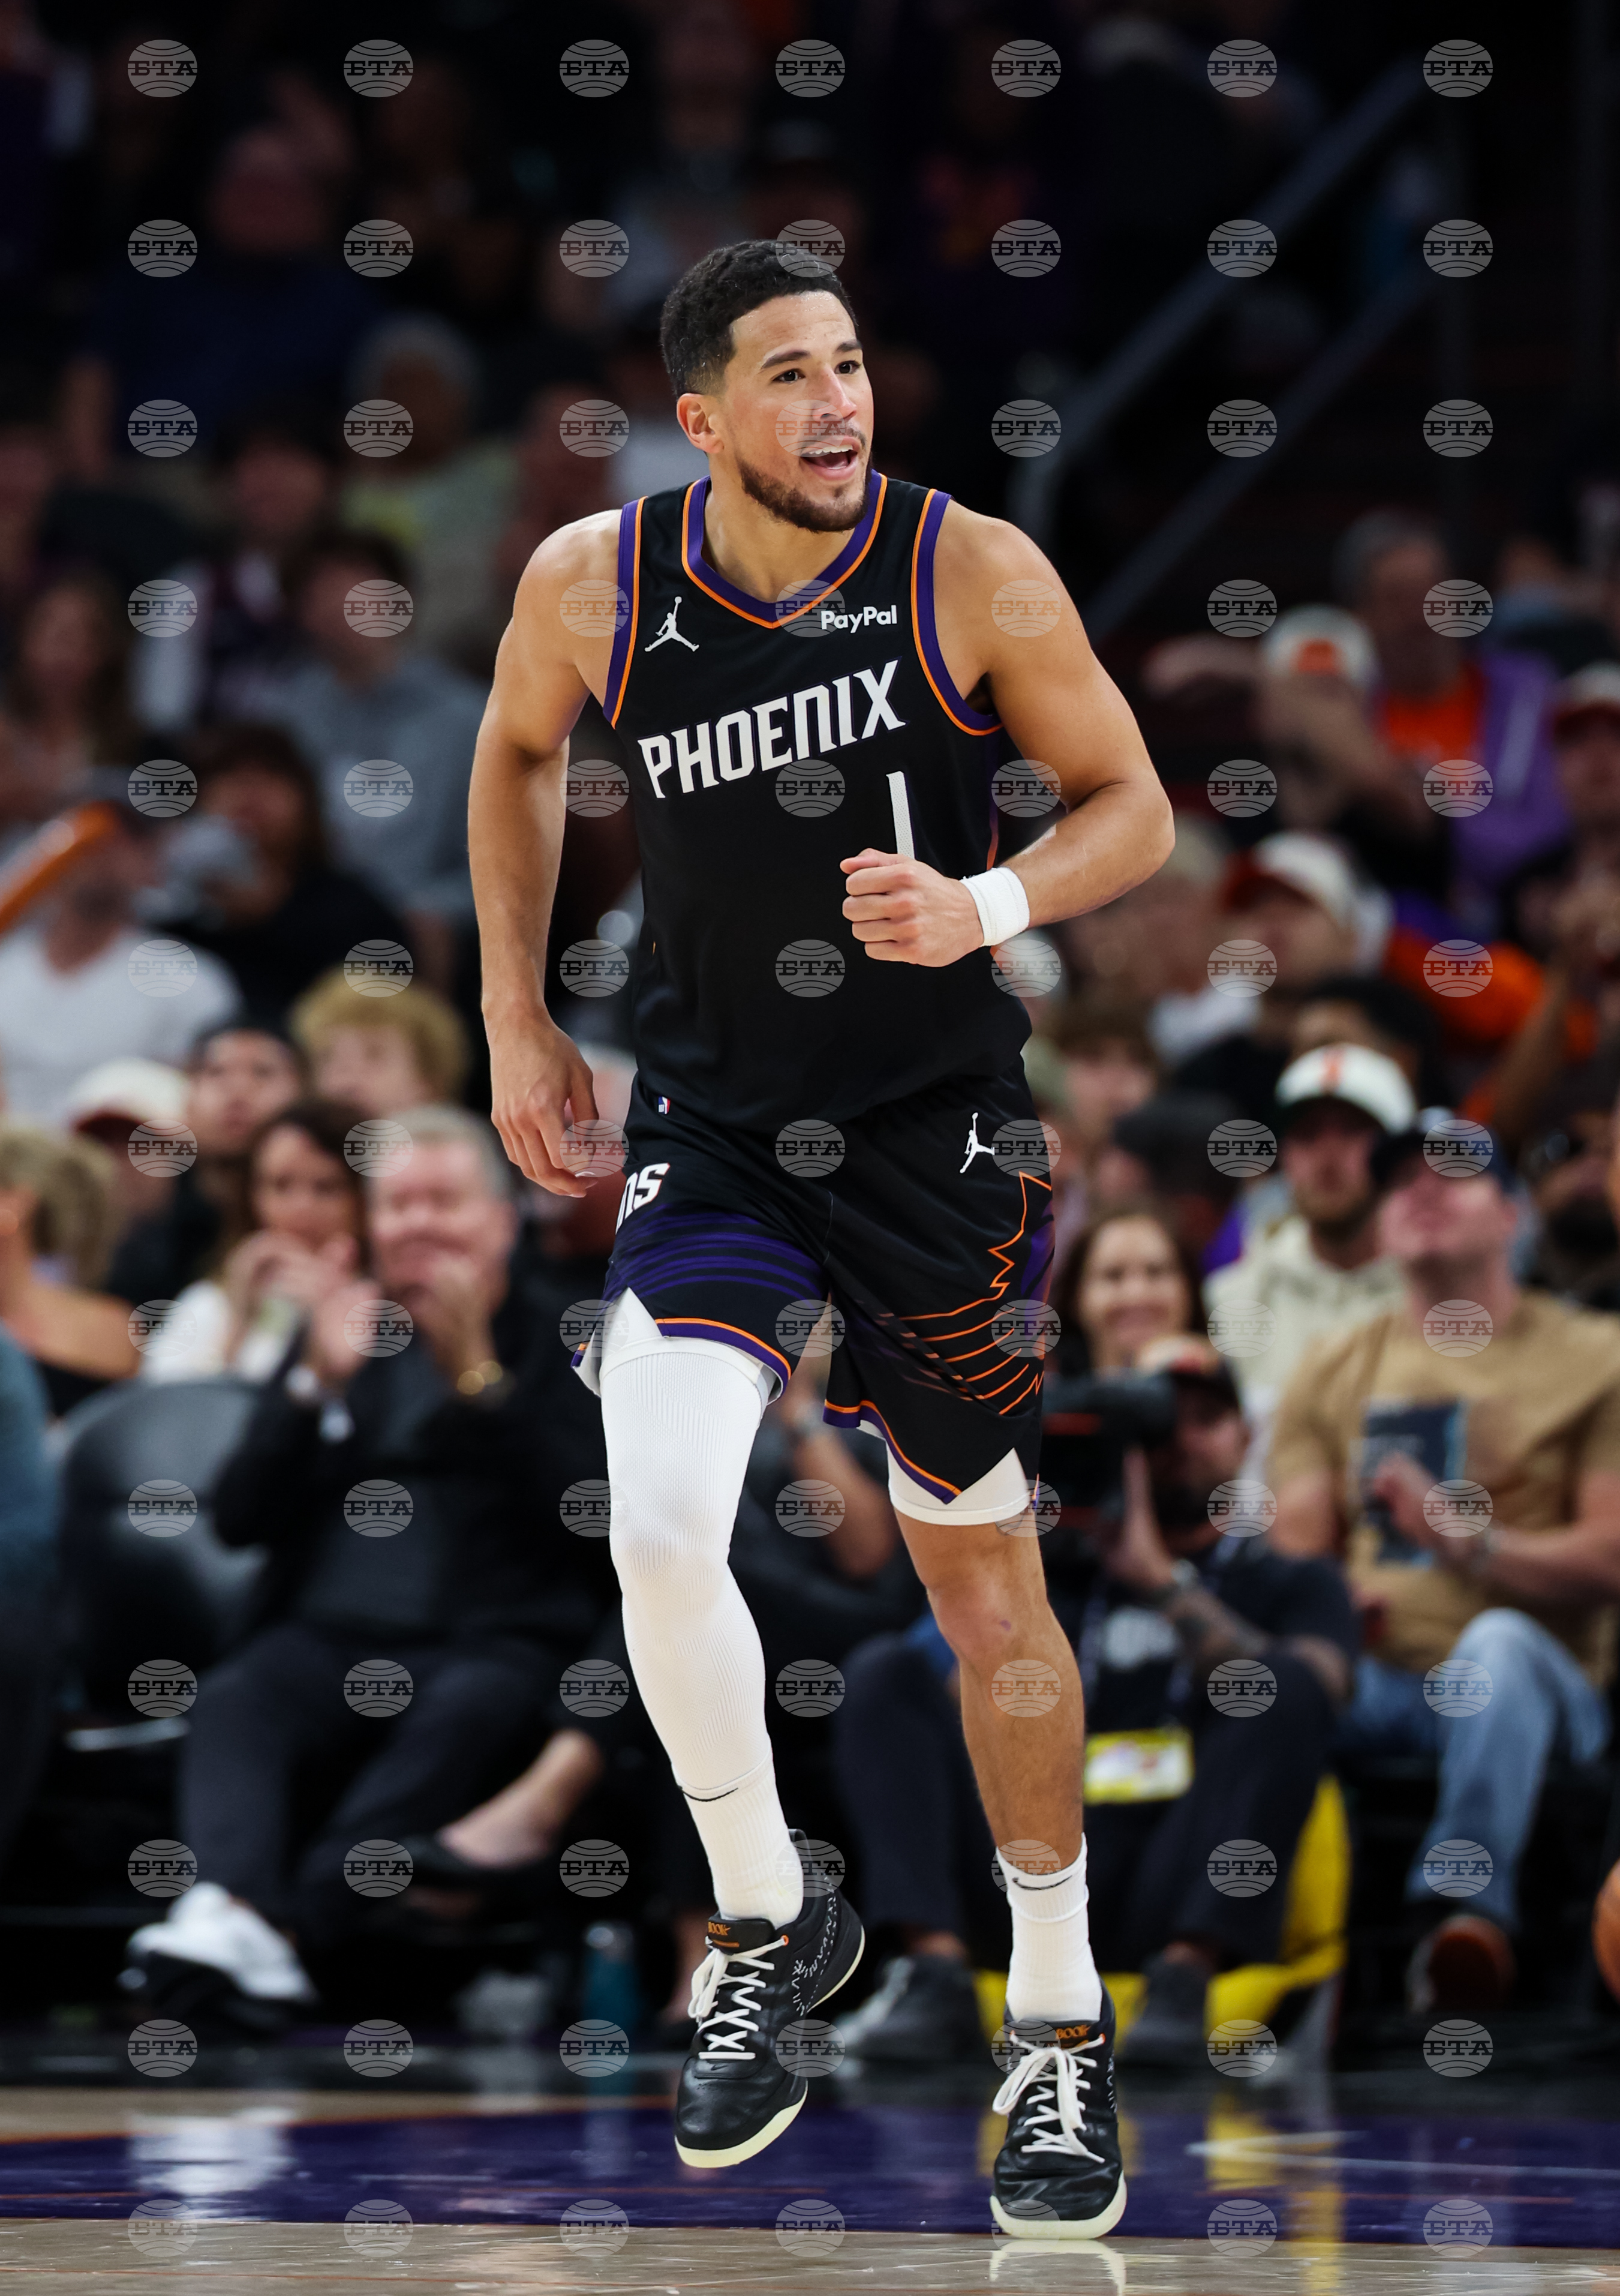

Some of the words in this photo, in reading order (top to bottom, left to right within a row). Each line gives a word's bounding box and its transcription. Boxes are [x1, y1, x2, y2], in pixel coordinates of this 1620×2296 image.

[821, 605, 897, 634] PayPal
[637, 659, 906, 799] PHOENIX
[886, 771, 915, 860] 1
[615, 1163, 671, 1235] NS
